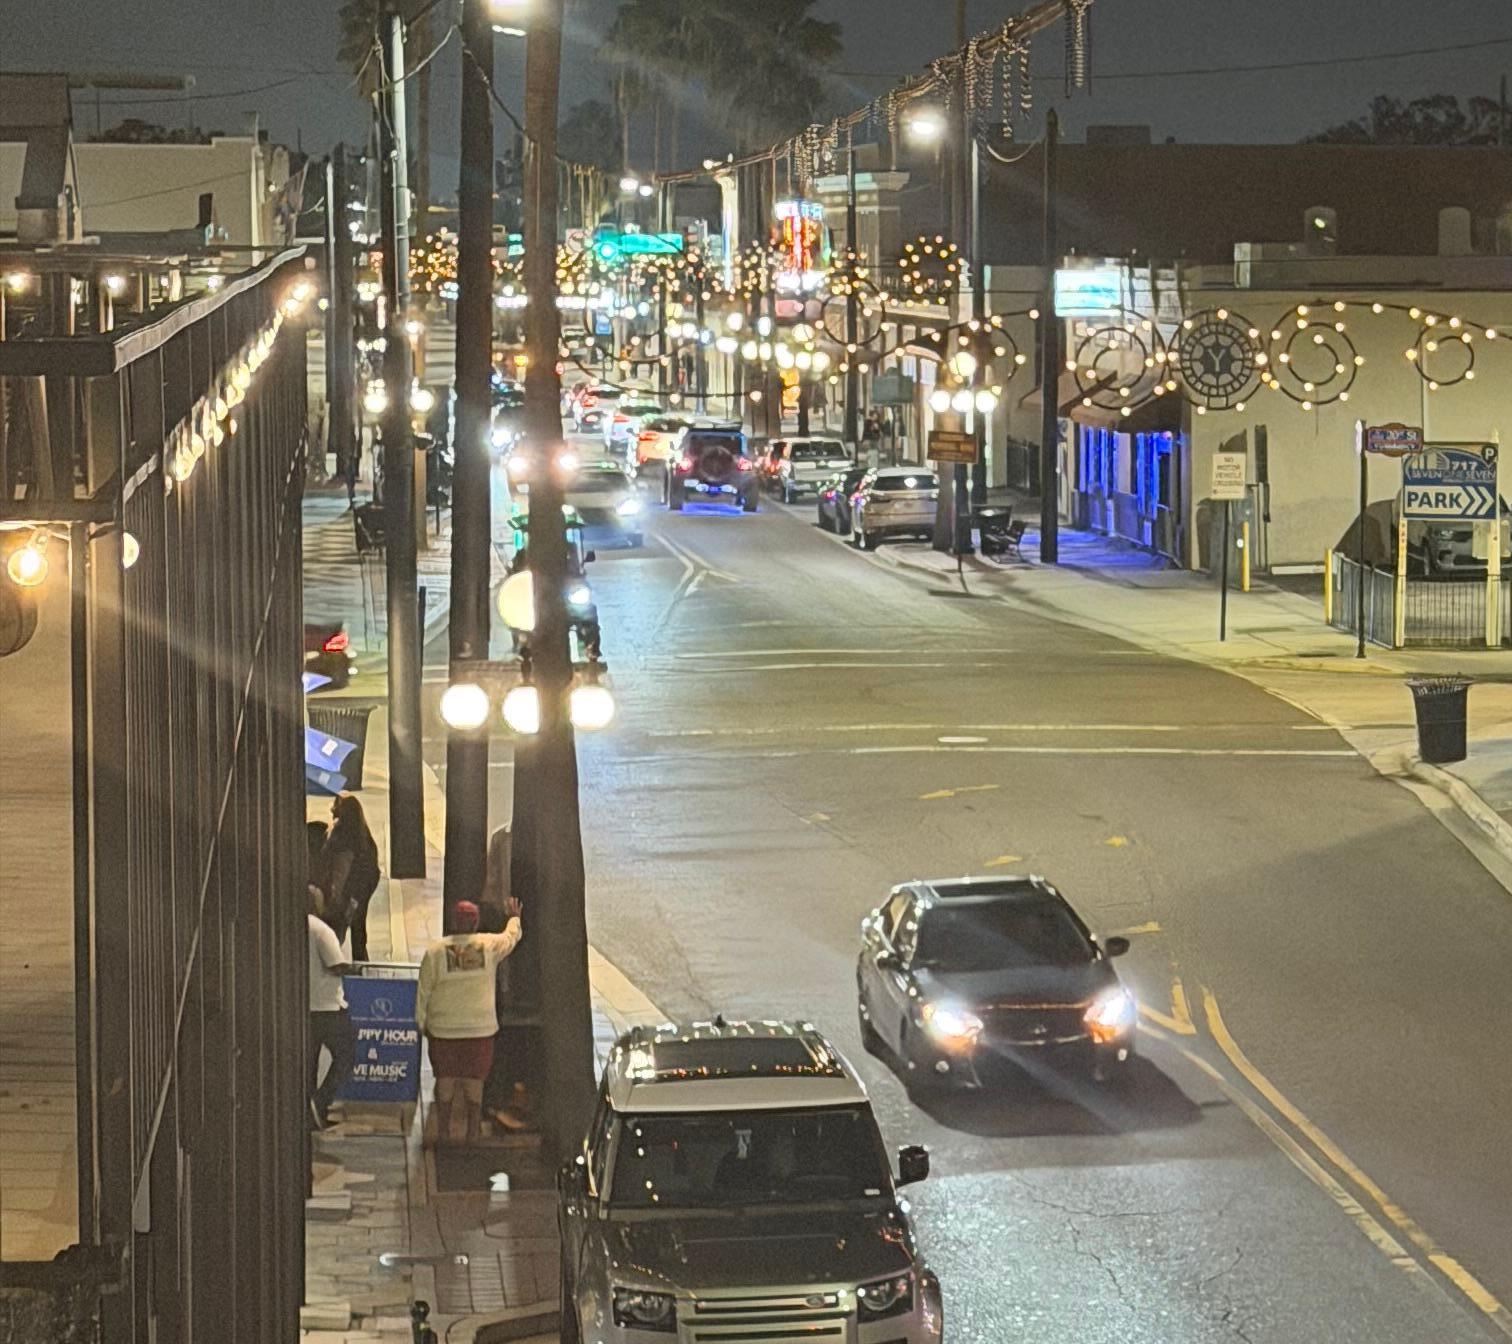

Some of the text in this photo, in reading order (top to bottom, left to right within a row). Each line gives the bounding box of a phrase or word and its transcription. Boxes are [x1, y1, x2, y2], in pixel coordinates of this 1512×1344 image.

[1207, 348, 1226, 372] Y
[1485, 448, 1495, 460] P
[1451, 461, 1478, 471] 717
[1411, 470, 1442, 479] SEVEN
[1465, 470, 1496, 481] SEVEN
[1407, 491, 1462, 508] PARK
[357, 1028, 418, 1042] PPY HOUR
[353, 1063, 407, 1078] VE MUSIC
